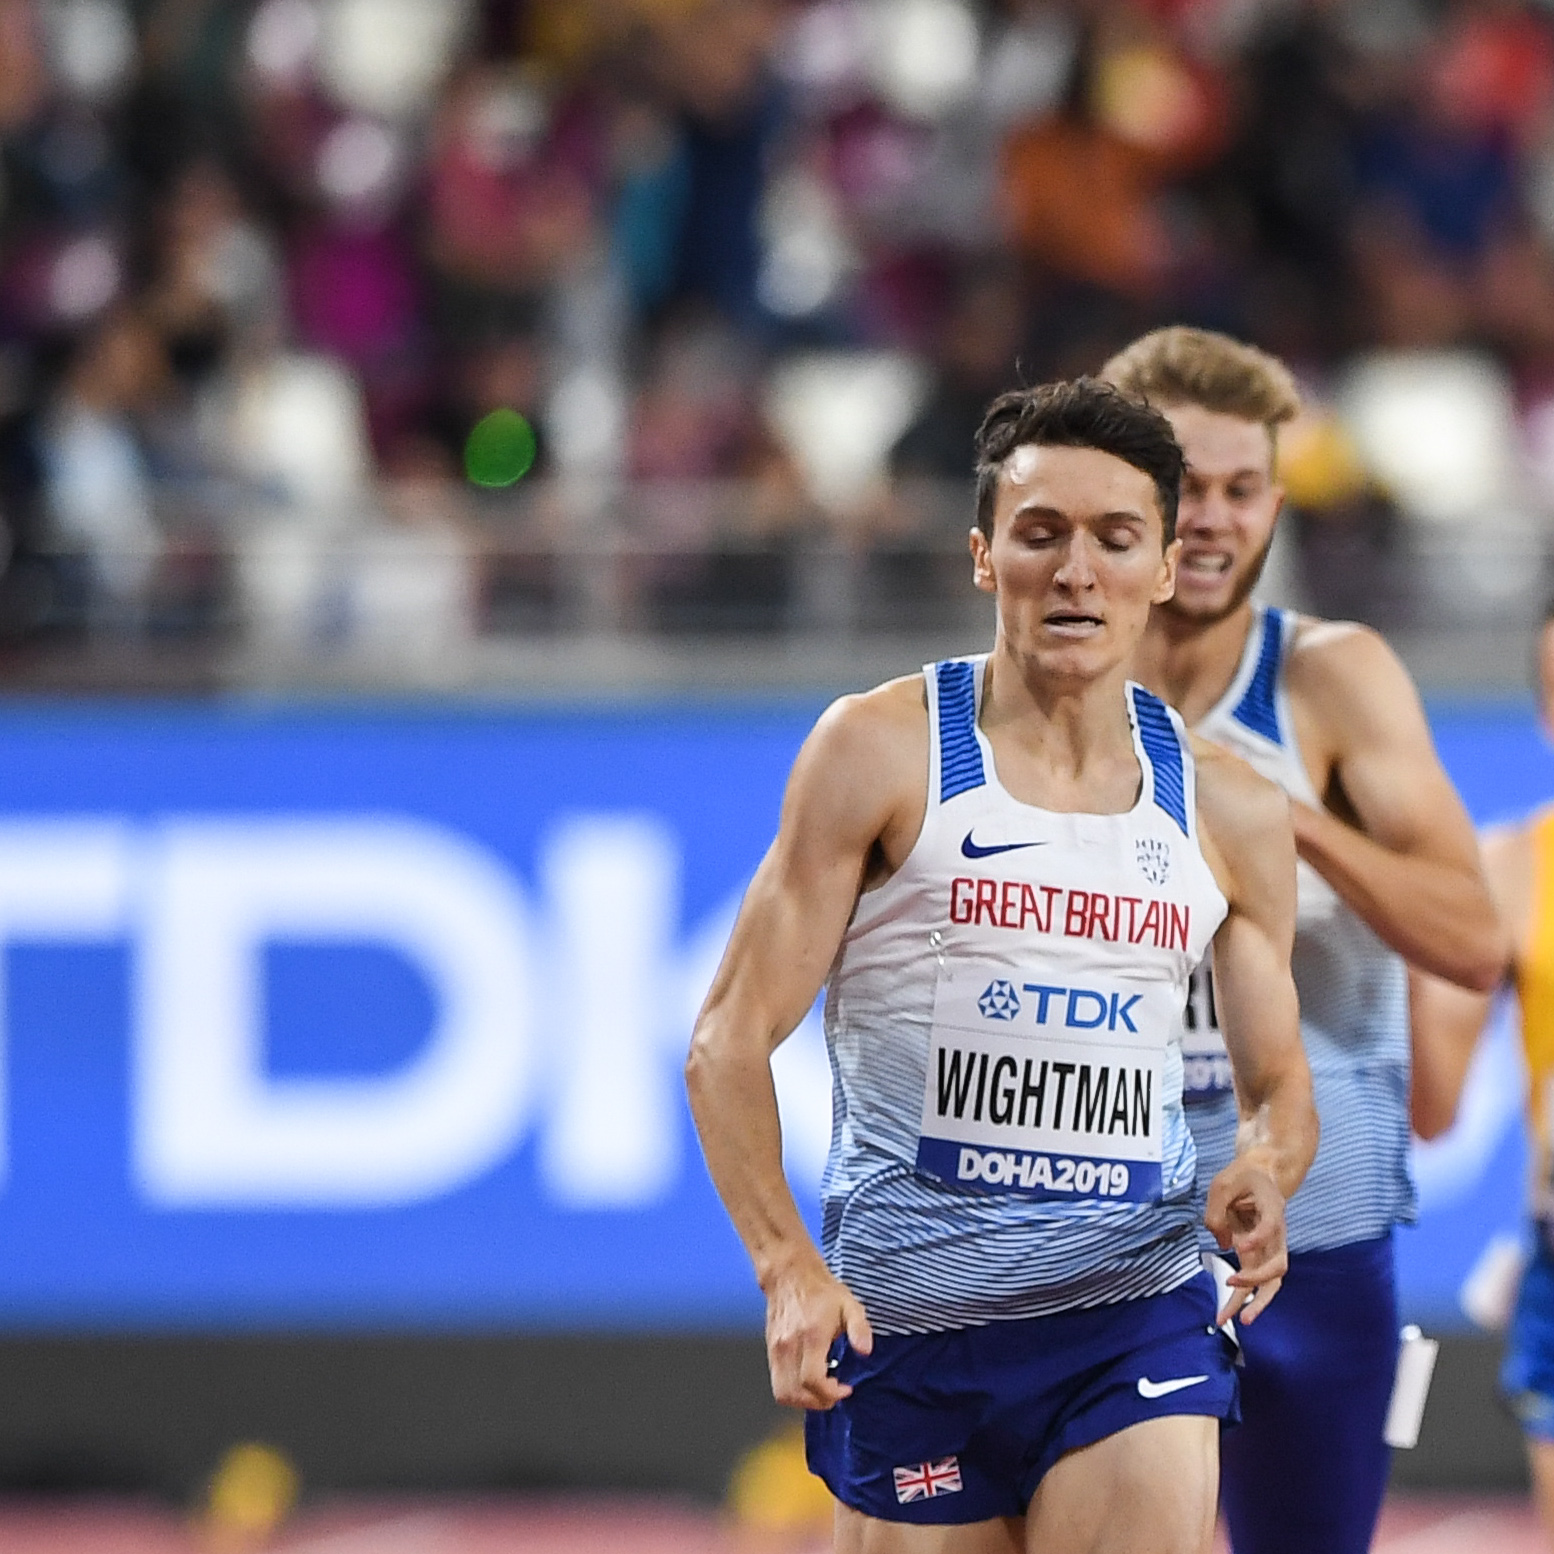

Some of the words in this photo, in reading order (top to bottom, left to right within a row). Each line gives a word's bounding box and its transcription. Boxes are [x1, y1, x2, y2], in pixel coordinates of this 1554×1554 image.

[949, 877, 1063, 934] GREAT
[1065, 893, 1190, 951] BRITAIN
[1022, 983, 1144, 1033] TDK
[936, 1047, 1152, 1137] WIGHTMAN
[957, 1149, 1129, 1195] DOHA2019
